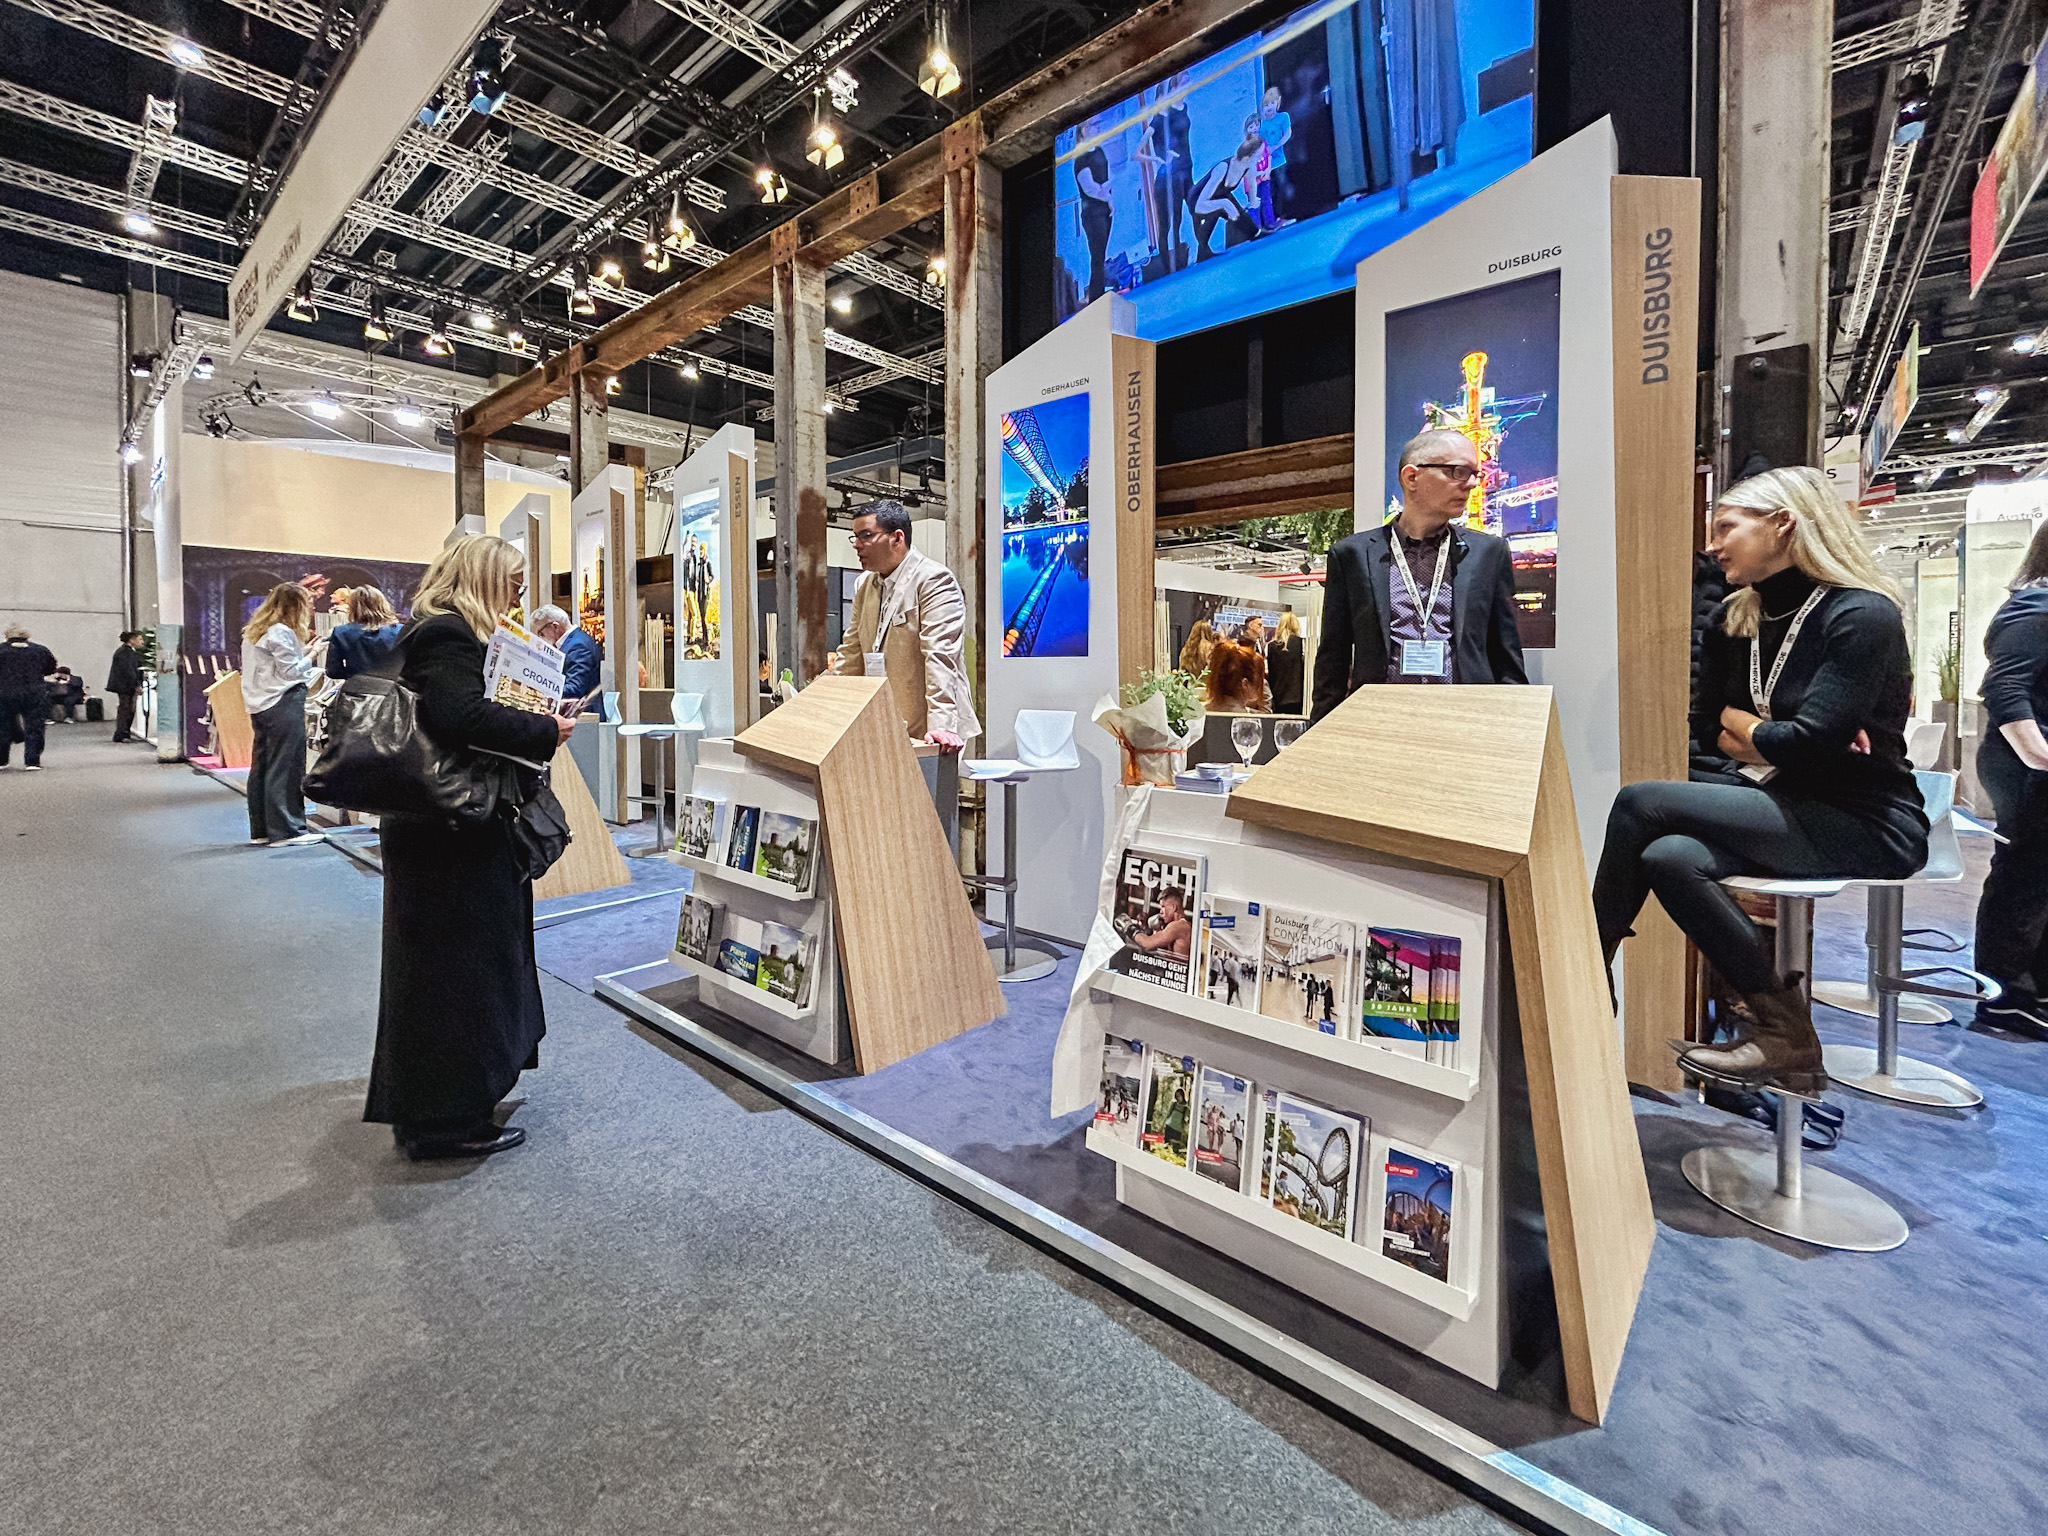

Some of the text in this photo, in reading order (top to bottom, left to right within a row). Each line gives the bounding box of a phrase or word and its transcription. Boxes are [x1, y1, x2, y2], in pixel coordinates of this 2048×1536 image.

[1488, 245, 1562, 274] DUISBURG
[1642, 227, 1673, 385] DUISBURG
[1041, 377, 1090, 396] OBERHAUSEN
[1127, 370, 1141, 512] OBERHAUSEN
[1996, 510, 2043, 521] Austria
[543, 645, 554, 657] ITB
[522, 667, 560, 695] CROATIA
[1124, 857, 1196, 896] ECHT
[1274, 915, 1309, 932] Duisburg
[1273, 927, 1342, 953] CONVENTION
[1132, 952, 1188, 974] DUISBURG GEHT
[1128, 967, 1161, 985] NÄCHSTE
[1160, 977, 1186, 992] RUNDE
[1164, 970, 1187, 983] IN DIE
[1386, 1004, 1418, 1014] JAHRE
